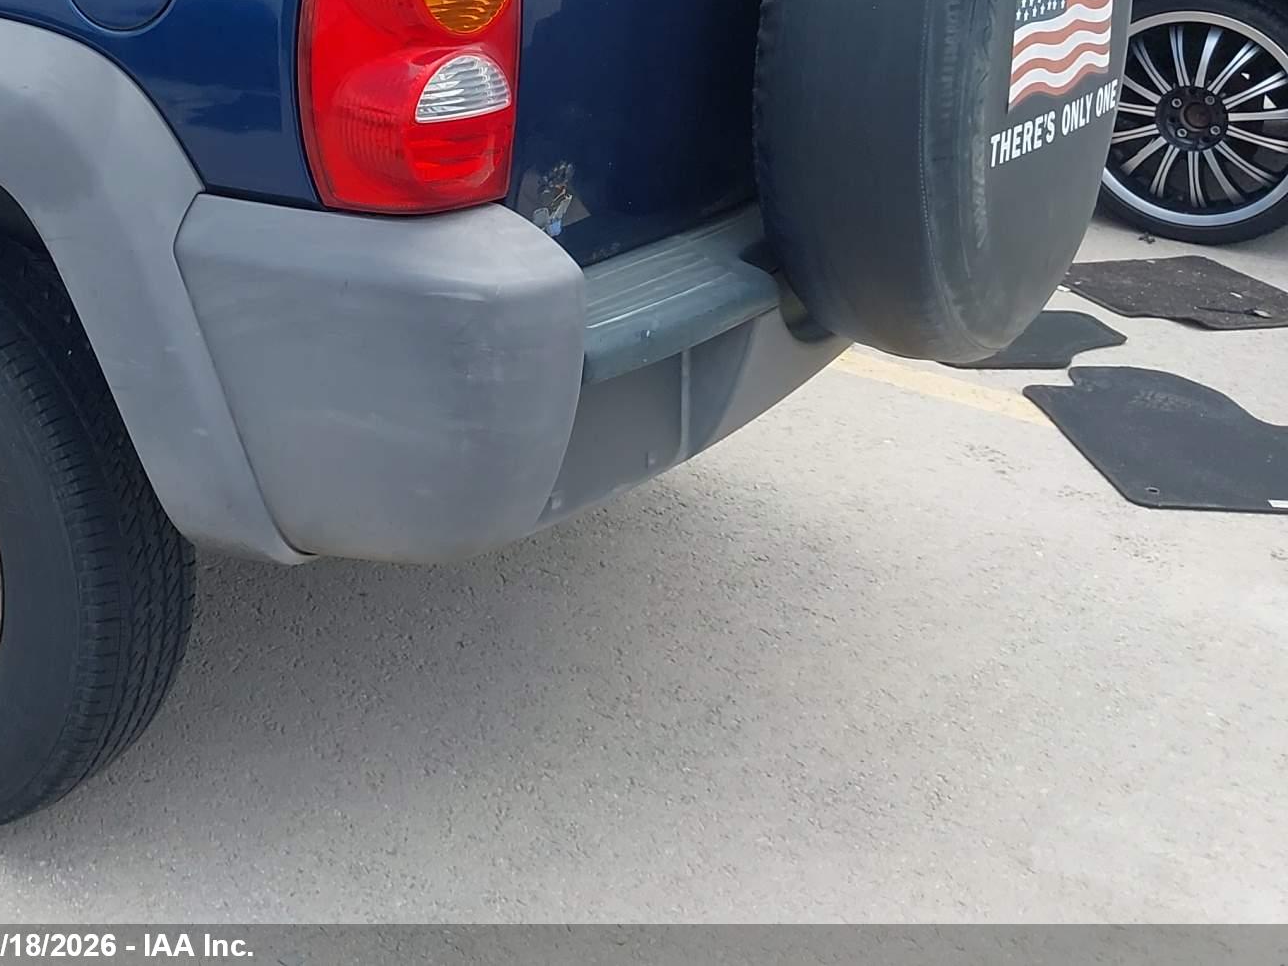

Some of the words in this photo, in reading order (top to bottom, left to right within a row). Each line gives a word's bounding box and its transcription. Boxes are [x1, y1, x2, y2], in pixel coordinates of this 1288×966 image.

[990, 110, 1056, 168] THERE'S
[1061, 92, 1094, 136] ONLY
[1095, 78, 1119, 118] ONE
